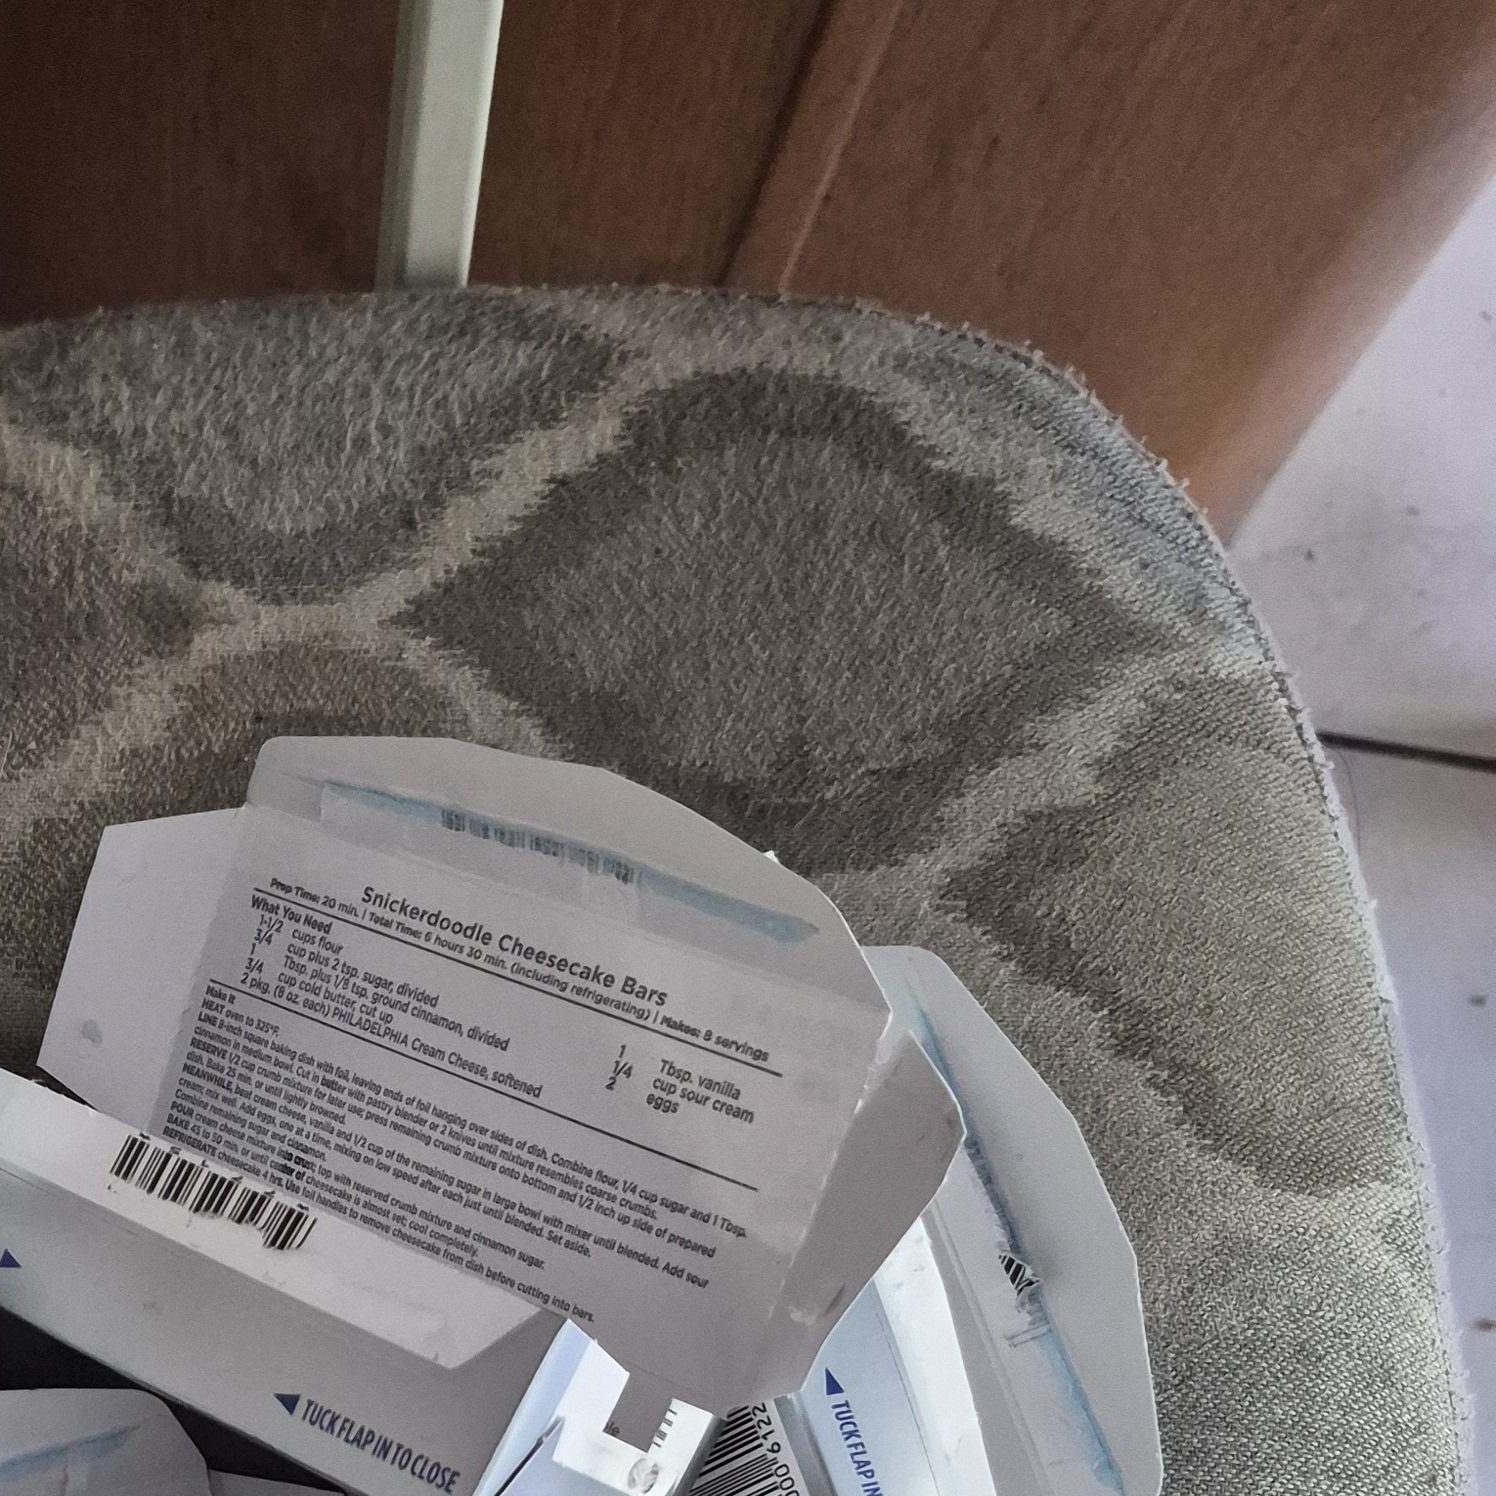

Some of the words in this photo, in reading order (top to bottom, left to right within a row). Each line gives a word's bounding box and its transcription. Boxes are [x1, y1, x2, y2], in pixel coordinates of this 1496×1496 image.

[250, 893, 280, 916] What
[302, 913, 333, 935] Need
[258, 913, 284, 933] 1-1/2
[291, 928, 316, 945] cups
[317, 935, 344, 955] flour
[360, 885, 492, 946] Snickerdoodle
[497, 933, 615, 988] Cheesecake
[620, 975, 668, 1006] Bars
[395, 981, 440, 1008] divided
[370, 991, 410, 1014] ground
[466, 1024, 511, 1052] divided
[301, 997, 330, 1018] each)
[330, 1006, 408, 1047] PHILADELPHIA
[410, 1036, 446, 1061] Cream
[490, 1070, 543, 1099] softened
[645, 1092, 679, 1114] eggs
[651, 1077, 677, 1095] cup
[678, 1087, 710, 1106] sour
[711, 1099, 754, 1124] cream
[659, 1057, 693, 1083] Tbsp.
[697, 1074, 741, 1100] vanilla
[298, 1398, 342, 1435] TUCK
[334, 1416, 377, 1452] FLAP
[370, 1434, 394, 1461] IN
[388, 1443, 414, 1472] TO
[407, 1452, 461, 1494] CLOSE
[750, 1401, 781, 1455] 6122
[831, 1400, 861, 1442] TUCK
[846, 1440, 875, 1479] FLAP
